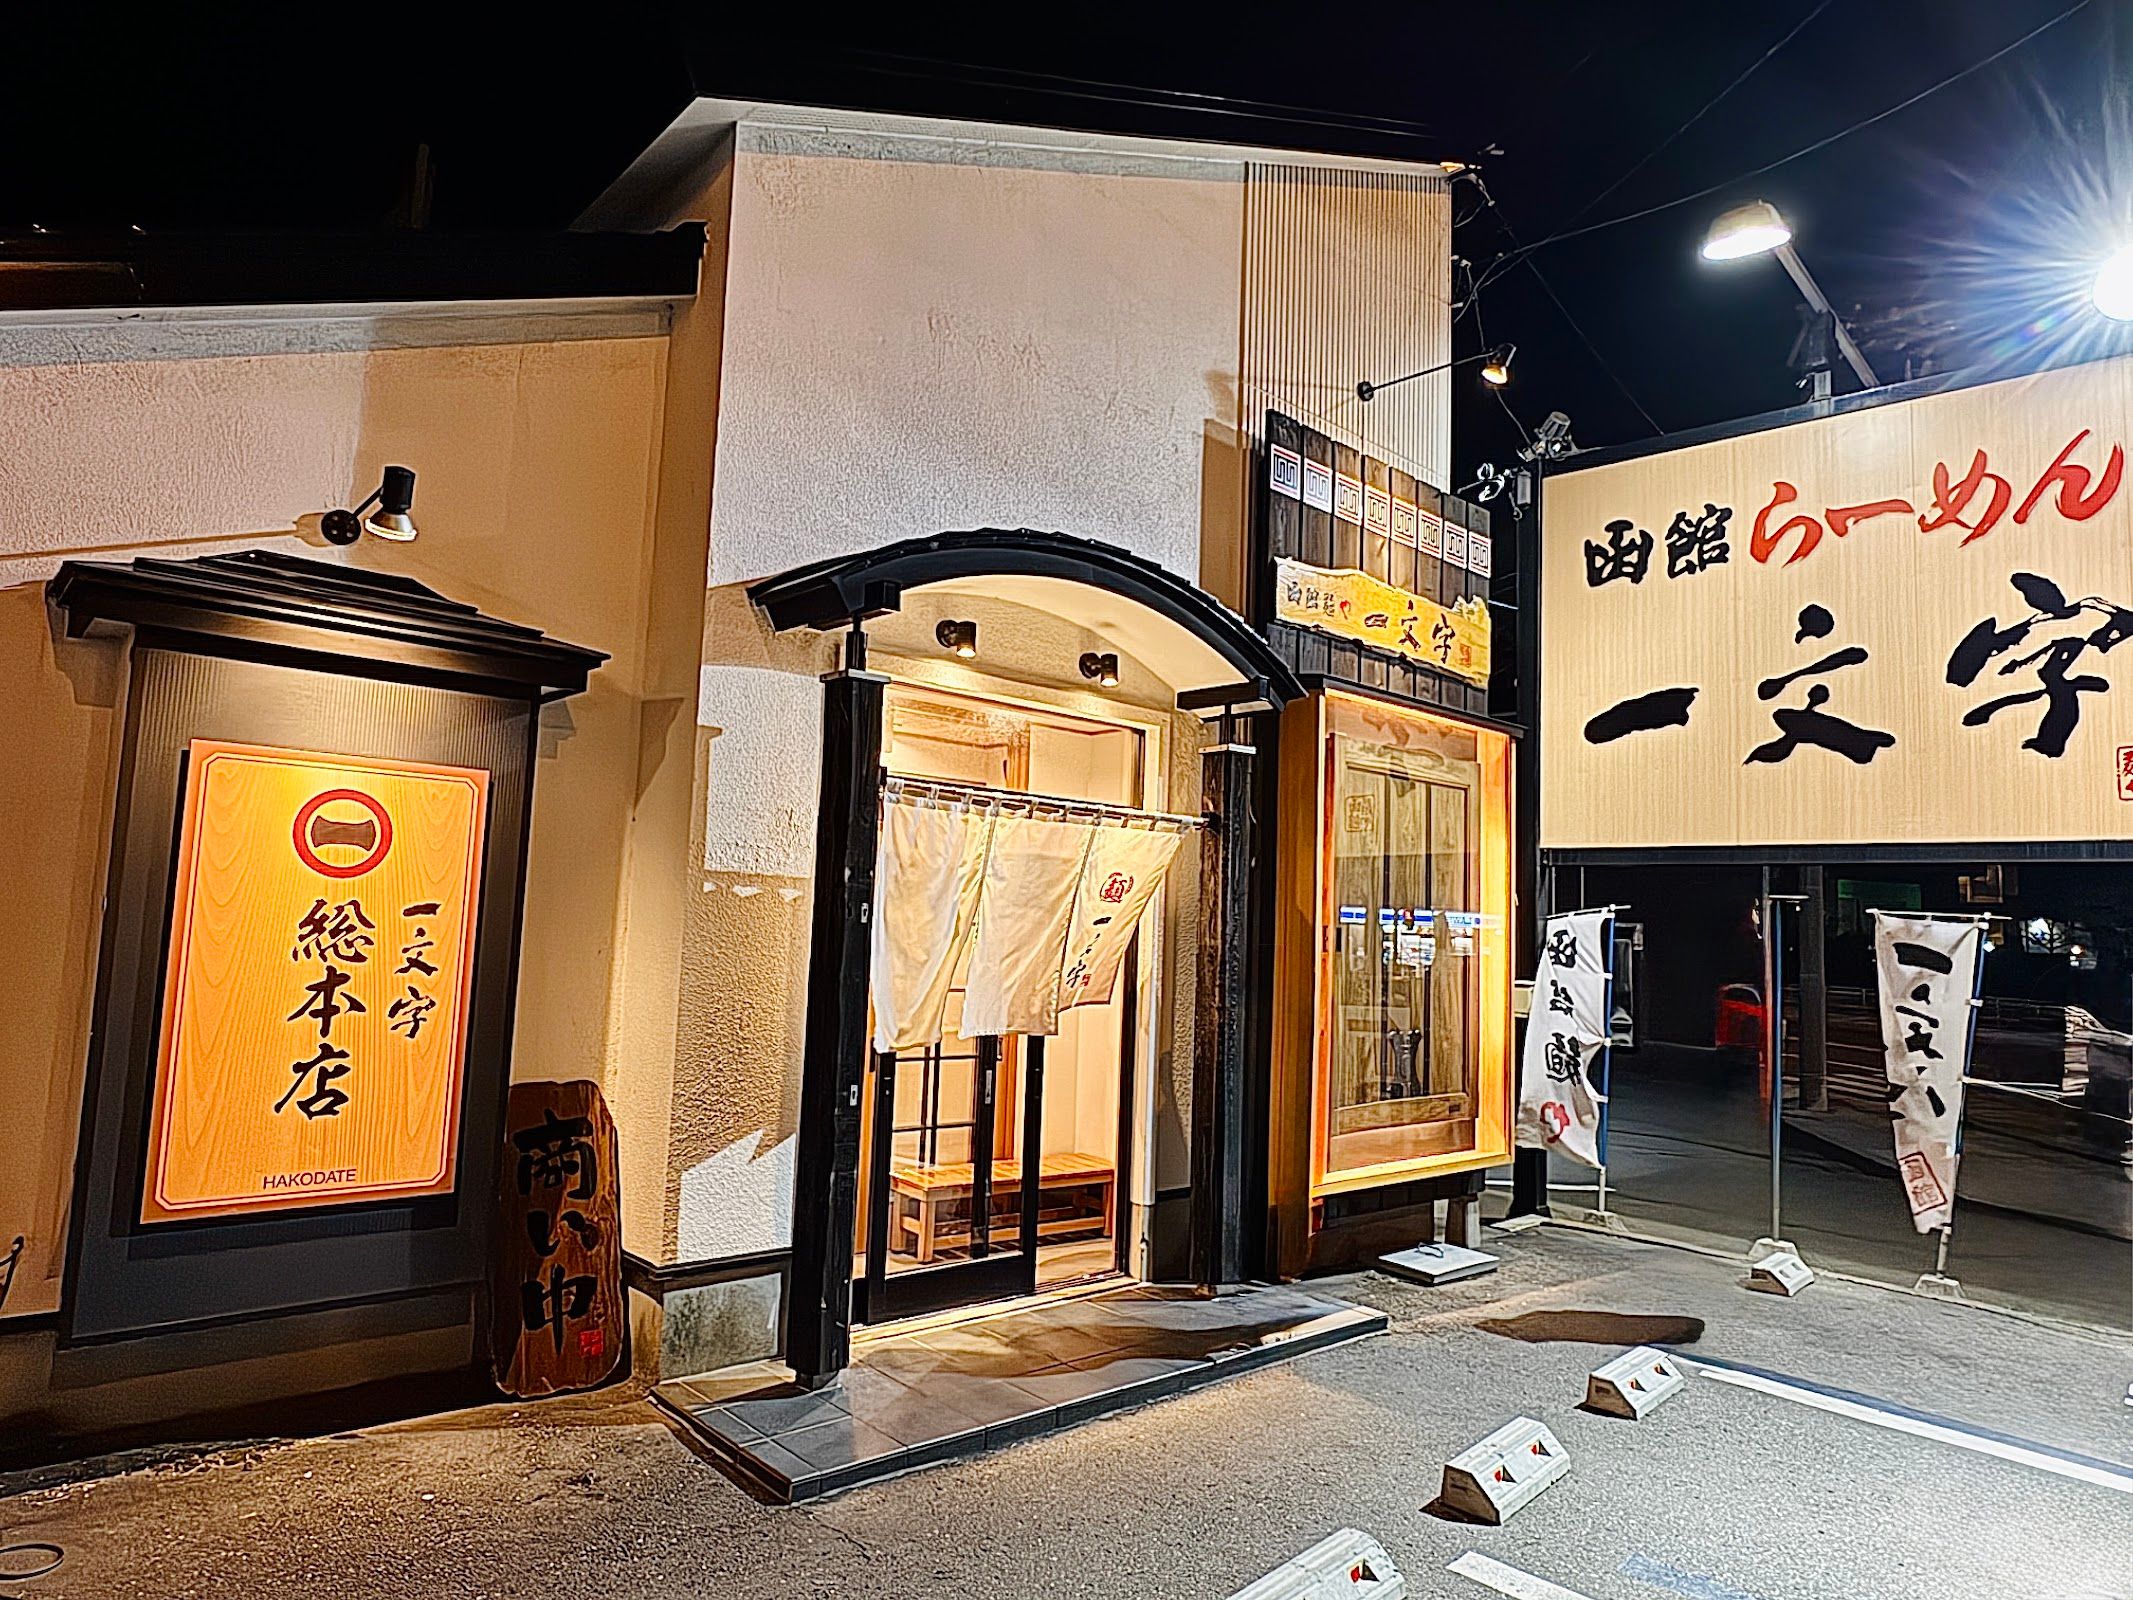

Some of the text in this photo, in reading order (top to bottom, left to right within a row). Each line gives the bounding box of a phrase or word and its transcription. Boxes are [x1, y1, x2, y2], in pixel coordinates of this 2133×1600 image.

[1584, 572, 2133, 765] 一文字
[275, 899, 376, 1120] 総本店
[388, 901, 441, 1038] 一文字
[263, 1168, 357, 1190] HAKODATE
[513, 1108, 600, 1357] 商い中
